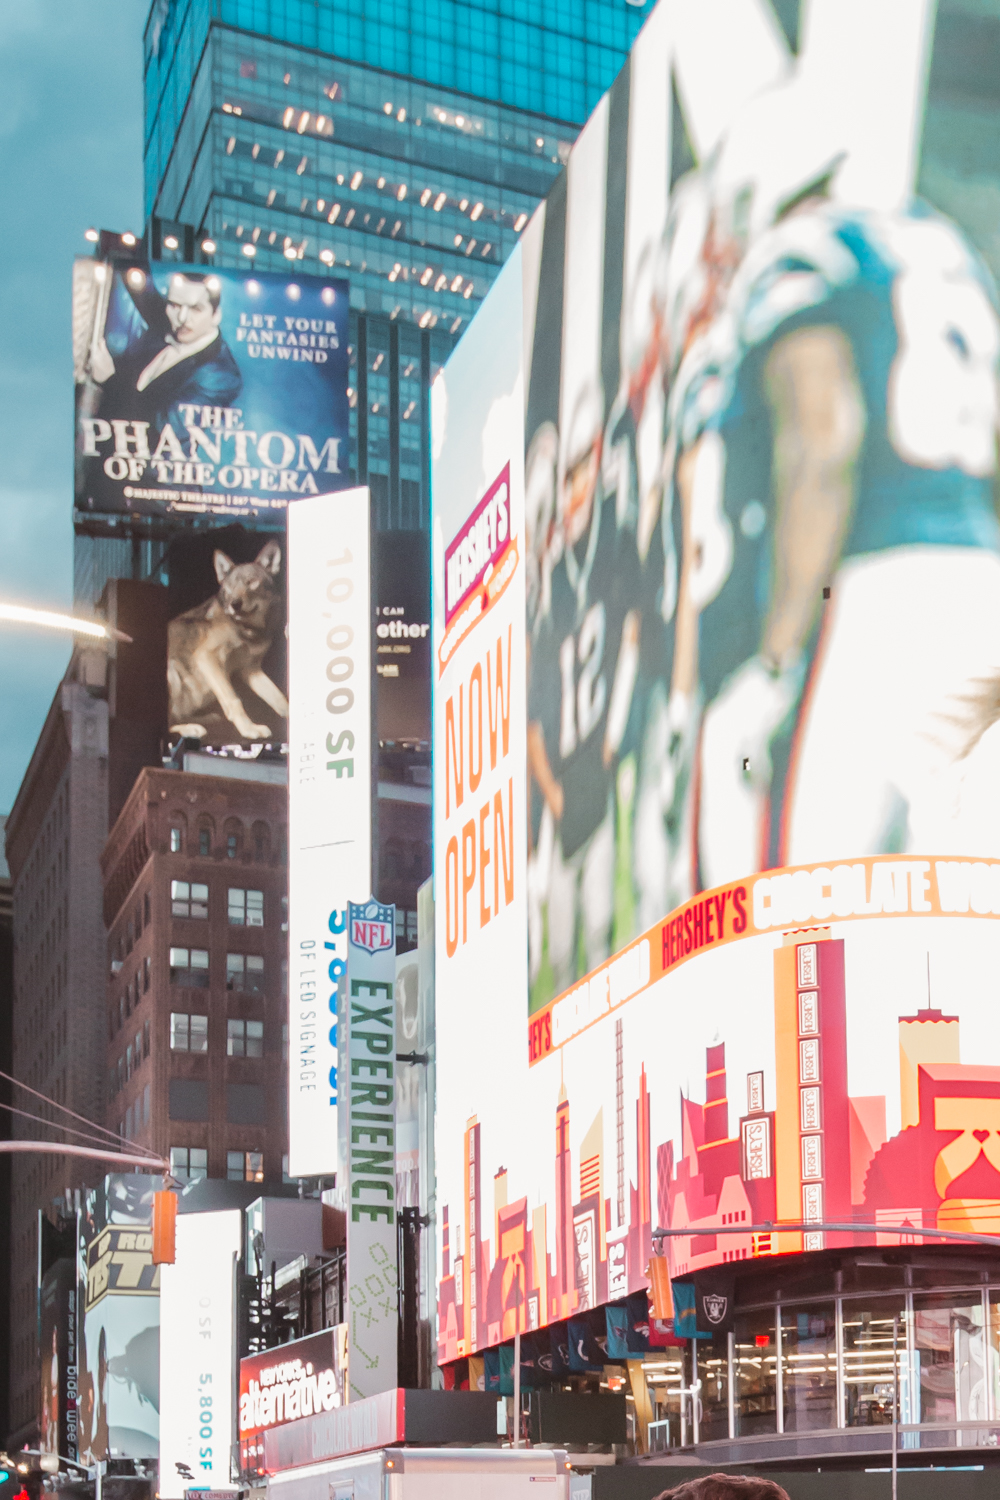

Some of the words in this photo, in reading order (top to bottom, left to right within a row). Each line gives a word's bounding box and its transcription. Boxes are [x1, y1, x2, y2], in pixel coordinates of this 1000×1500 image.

[236, 328, 339, 350] FANTASIES
[240, 313, 276, 330] LET
[285, 317, 337, 334] YOUR
[248, 345, 328, 364] UNWIND
[179, 403, 243, 430] THE
[80, 418, 342, 474] PHANTOM
[104, 456, 146, 481] OF
[151, 460, 215, 485] THE
[218, 465, 320, 495] OPERA
[322, 547, 355, 715] 10,000
[445, 623, 513, 820] NOW
[326, 729, 355, 779] SF
[445, 776, 514, 958] OPEN
[300, 940, 316, 960] OF
[354, 921, 391, 948] NFL
[662, 886, 748, 971] HERSHEY'S
[300, 970, 316, 1002] LED
[300, 1011, 316, 1092] SIGNAGE
[351, 979, 394, 1224] EXPERIENCE
[198, 1373, 213, 1440] 5,800
[200, 1448, 213, 1470] SF
